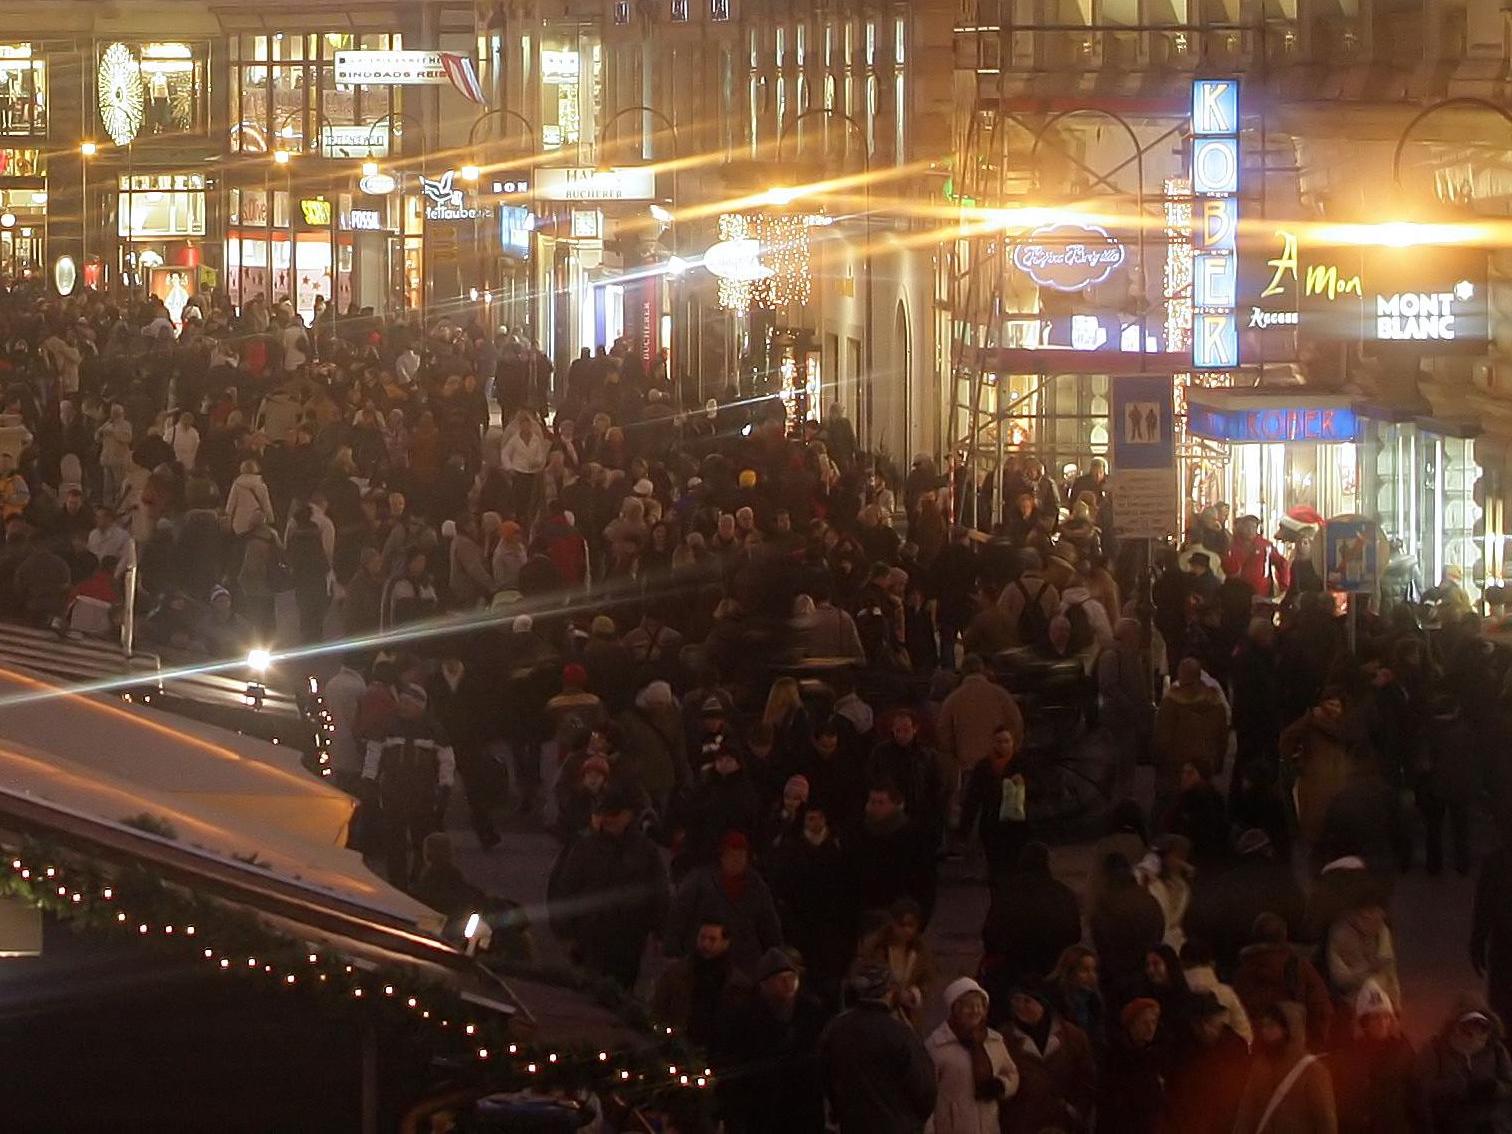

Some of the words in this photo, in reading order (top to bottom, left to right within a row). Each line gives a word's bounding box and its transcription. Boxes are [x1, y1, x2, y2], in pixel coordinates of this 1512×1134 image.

[566, 189, 623, 199] BUCHERER
[1196, 82, 1235, 365] KOBER
[1377, 293, 1455, 316] MONT
[1377, 315, 1455, 340] BLANC
